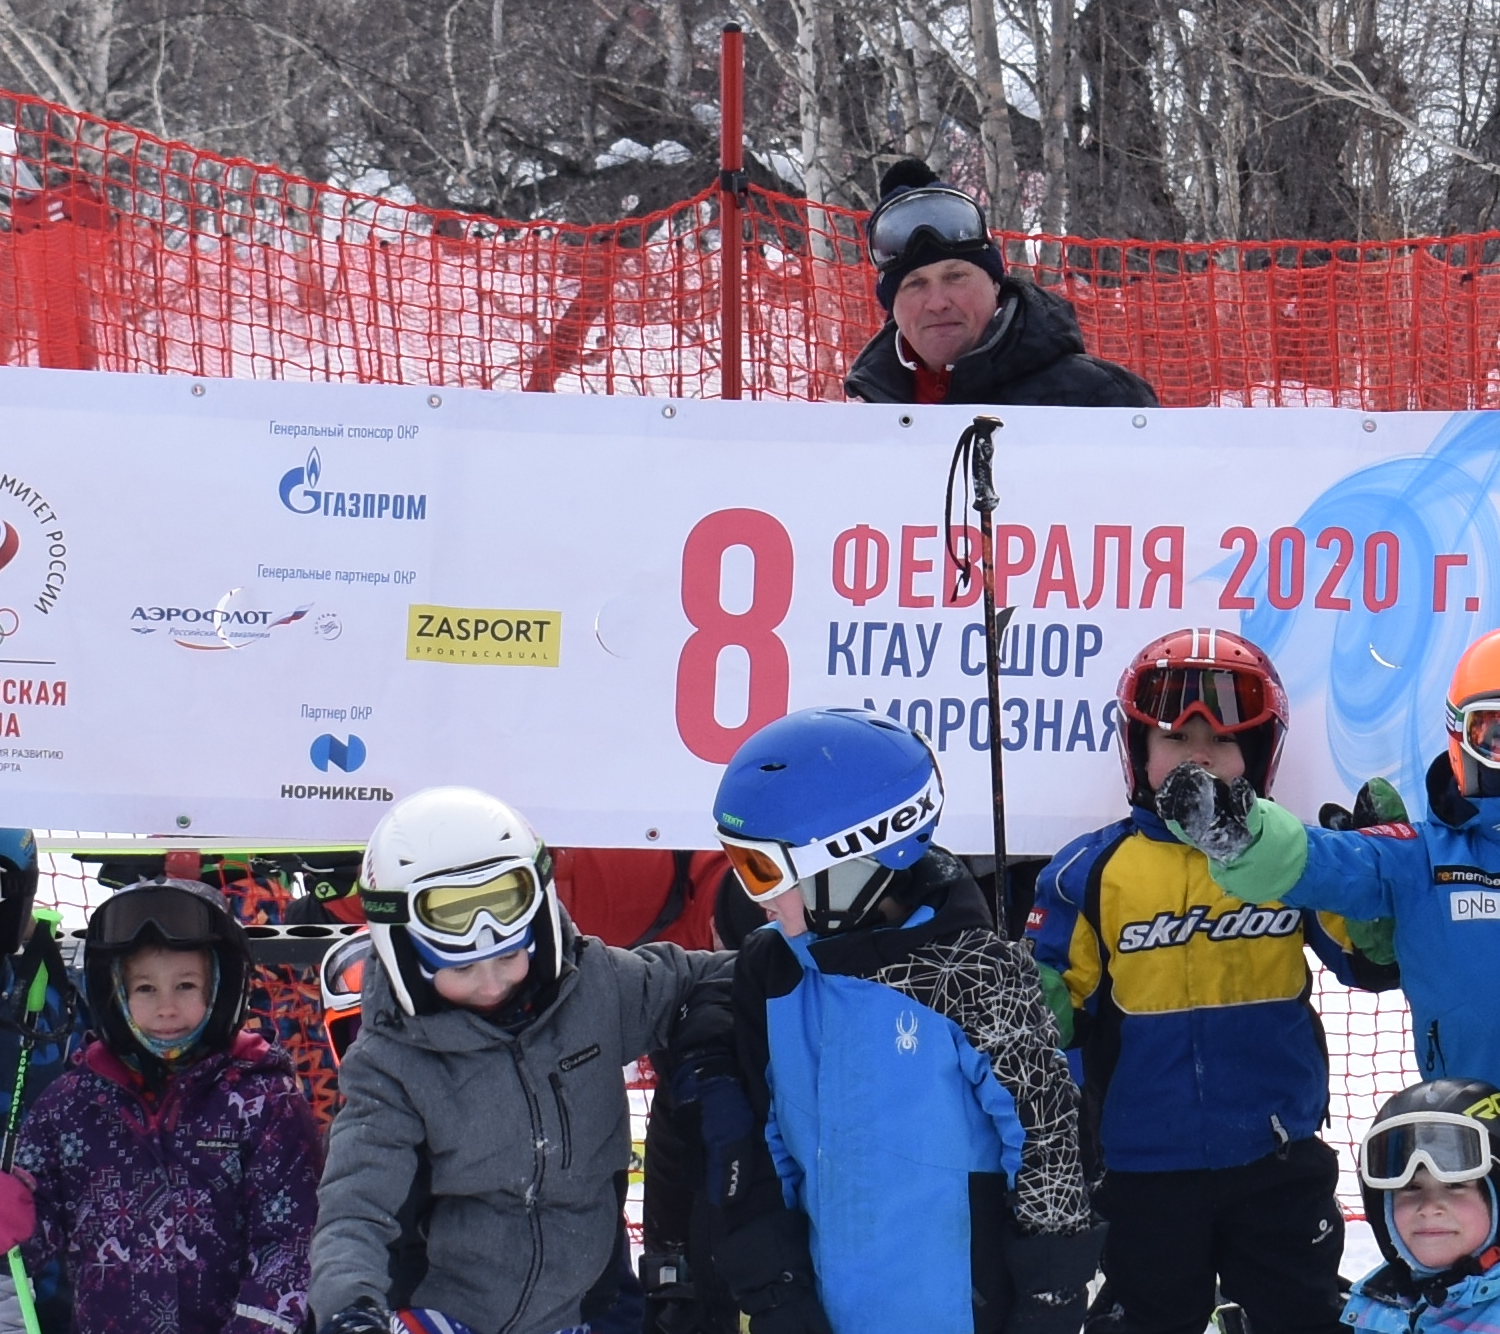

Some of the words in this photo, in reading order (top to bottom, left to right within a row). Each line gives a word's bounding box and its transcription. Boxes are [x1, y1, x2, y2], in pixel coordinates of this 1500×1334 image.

[269, 419, 344, 442] Генеральный
[347, 425, 395, 443] спонсор
[397, 423, 420, 440] ОКР
[322, 491, 427, 521] ГАЗПРОМ
[33, 530, 68, 616] РОССИИ
[257, 563, 333, 583] Генеральные
[335, 568, 390, 588] партнеры
[393, 570, 417, 585] ОКР
[129, 606, 273, 626] АЭРОФЛОТ
[416, 614, 552, 644] ZASPORT
[674, 507, 796, 766] 8
[831, 522, 1186, 612] ФЕВРАЛЯ
[1218, 525, 1402, 613] 2020
[1431, 553, 1483, 614] г.
[826, 621, 944, 678] КГАУ
[959, 622, 1104, 679] СШОР
[300, 703, 348, 723] Партнер
[350, 705, 373, 721] ОКР
[11, 748, 65, 760] РАЗВИТИЮ
[280, 784, 394, 802] НОРНИКЕЛЬ
[825, 787, 936, 859] uvex
[1457, 892, 1496, 919] DNB
[1118, 905, 1301, 951] ski-doo
